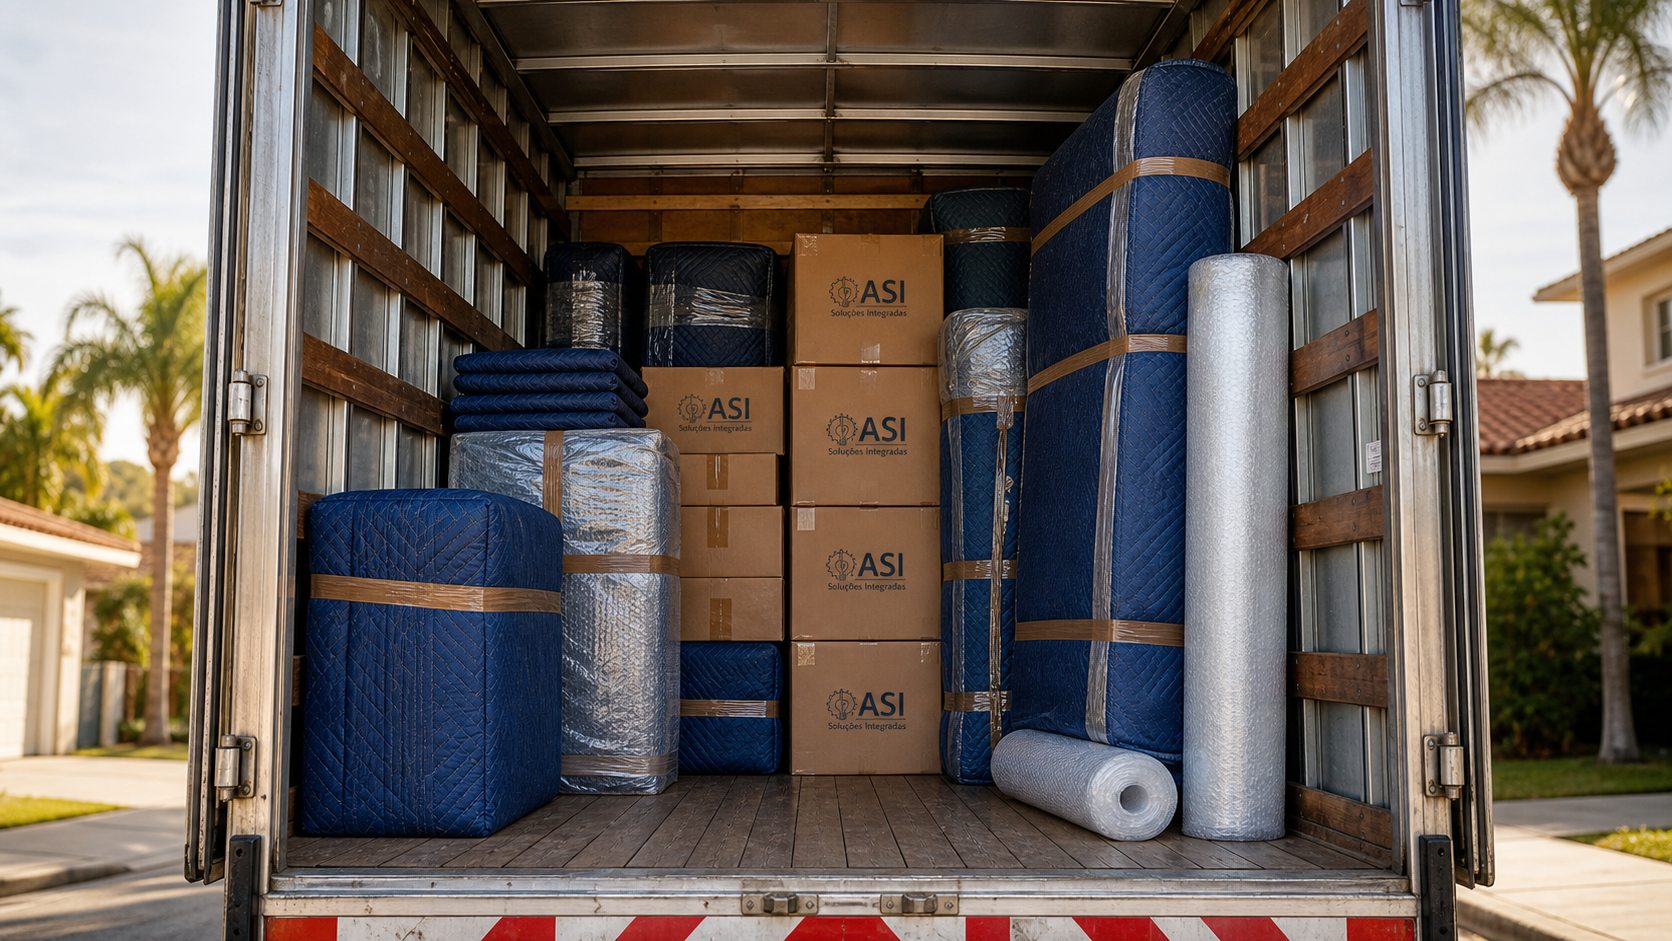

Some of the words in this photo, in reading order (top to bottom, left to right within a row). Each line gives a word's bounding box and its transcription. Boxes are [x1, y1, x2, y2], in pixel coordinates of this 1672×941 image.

[860, 279, 905, 304] ASI
[831, 309, 865, 319] Soluções
[708, 397, 750, 420] ASI
[858, 416, 906, 442] ASI
[828, 447, 864, 457] Soluções
[857, 552, 903, 577] ASI
[827, 582, 862, 592] Soluções
[858, 691, 904, 717] ASI
[828, 721, 863, 732] Soluções
